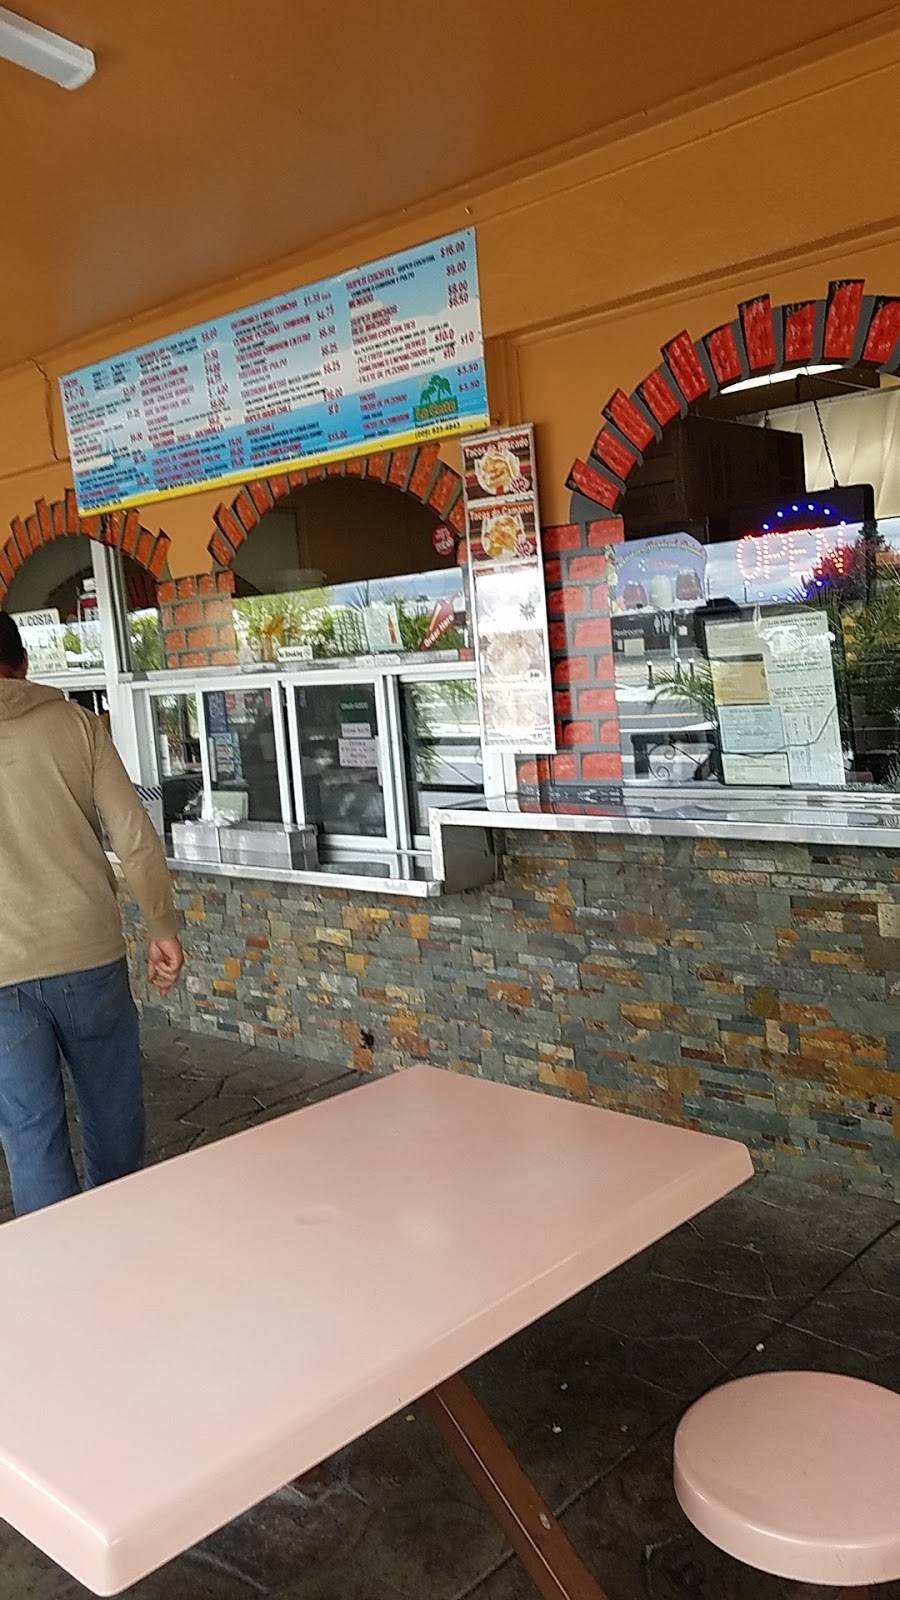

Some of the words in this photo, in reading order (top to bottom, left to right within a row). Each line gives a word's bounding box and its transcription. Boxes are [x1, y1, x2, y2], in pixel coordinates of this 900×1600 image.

[736, 525, 844, 580] OPEN
[27, 613, 54, 627] COSTA
[424, 628, 441, 648] Order
[438, 614, 455, 631] Here
